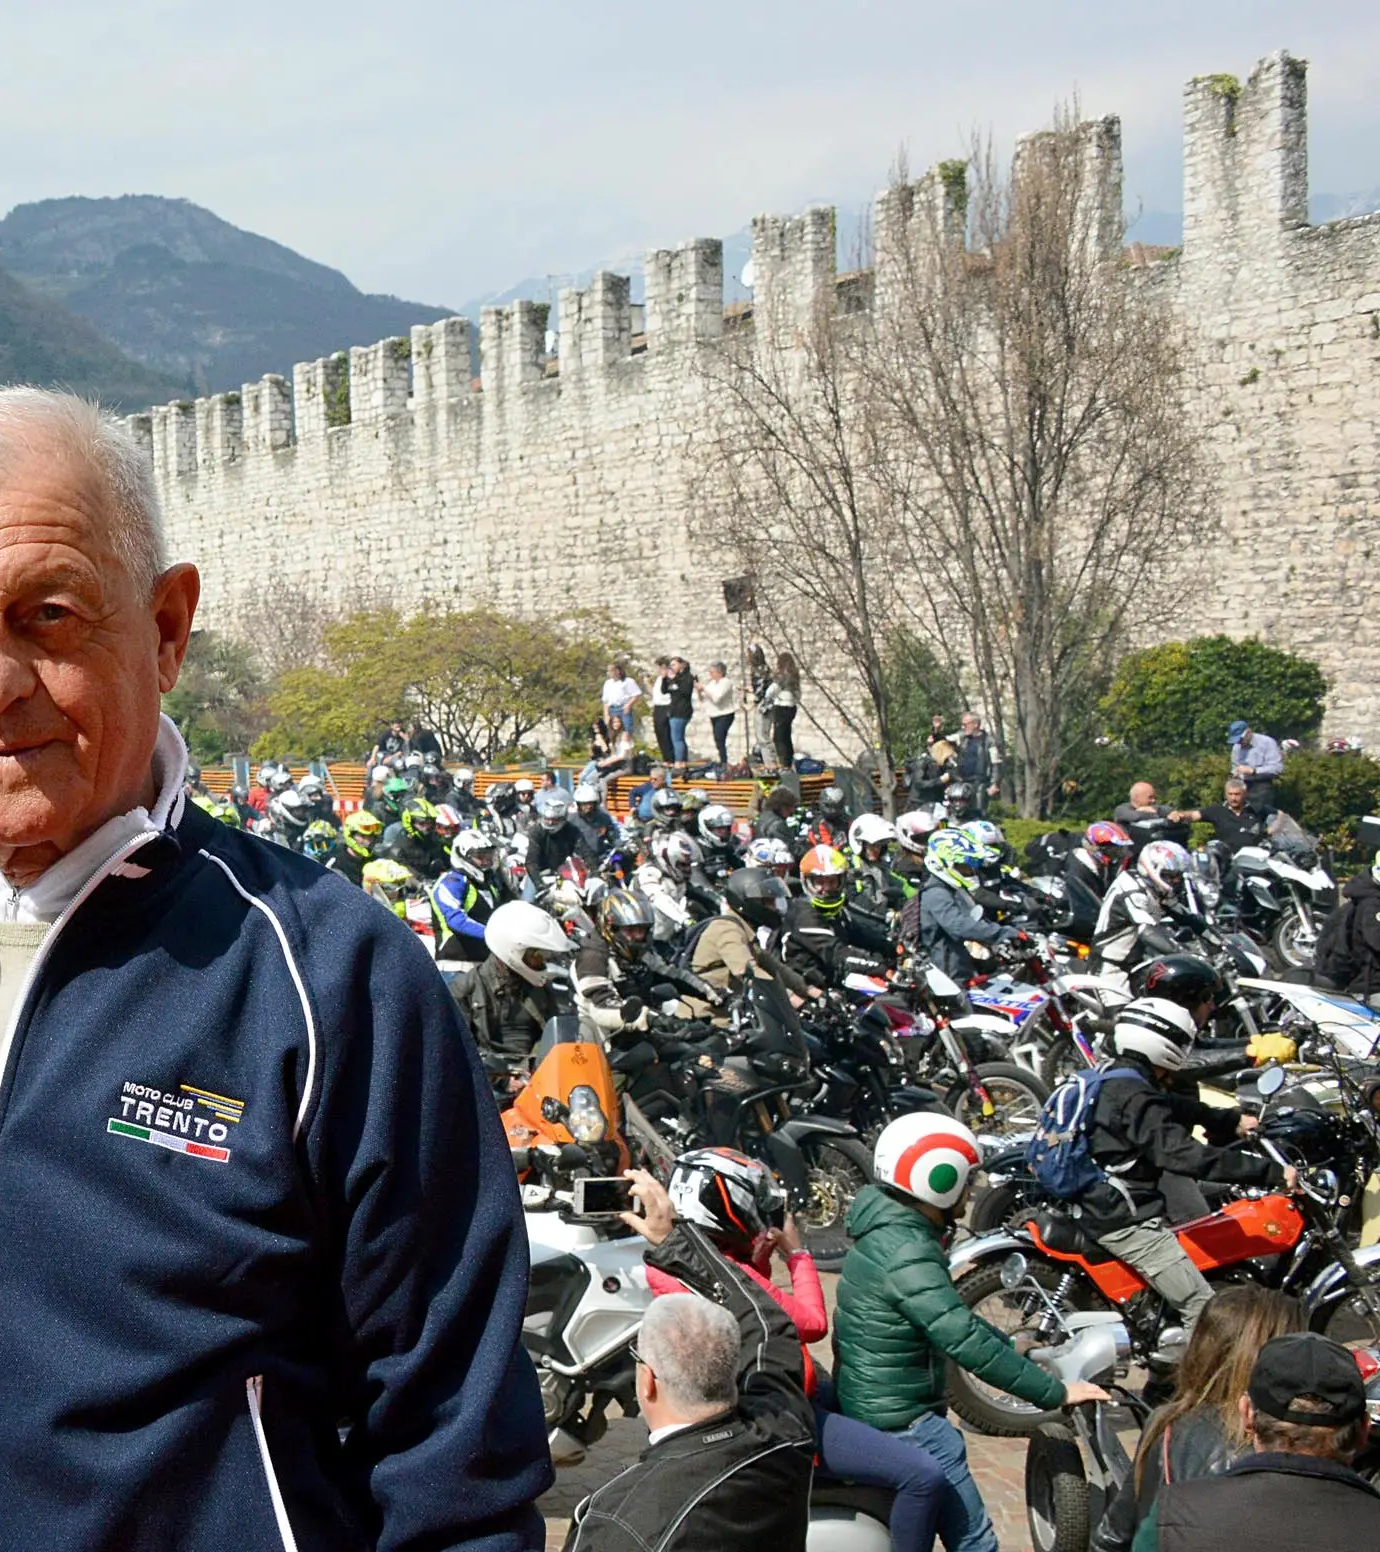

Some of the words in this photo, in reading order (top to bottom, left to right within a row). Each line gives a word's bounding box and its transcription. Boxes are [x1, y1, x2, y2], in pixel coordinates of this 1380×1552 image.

[123, 1081, 161, 1100] MOTO
[162, 1093, 195, 1110] CLUB
[120, 1095, 228, 1142] TRENTO
